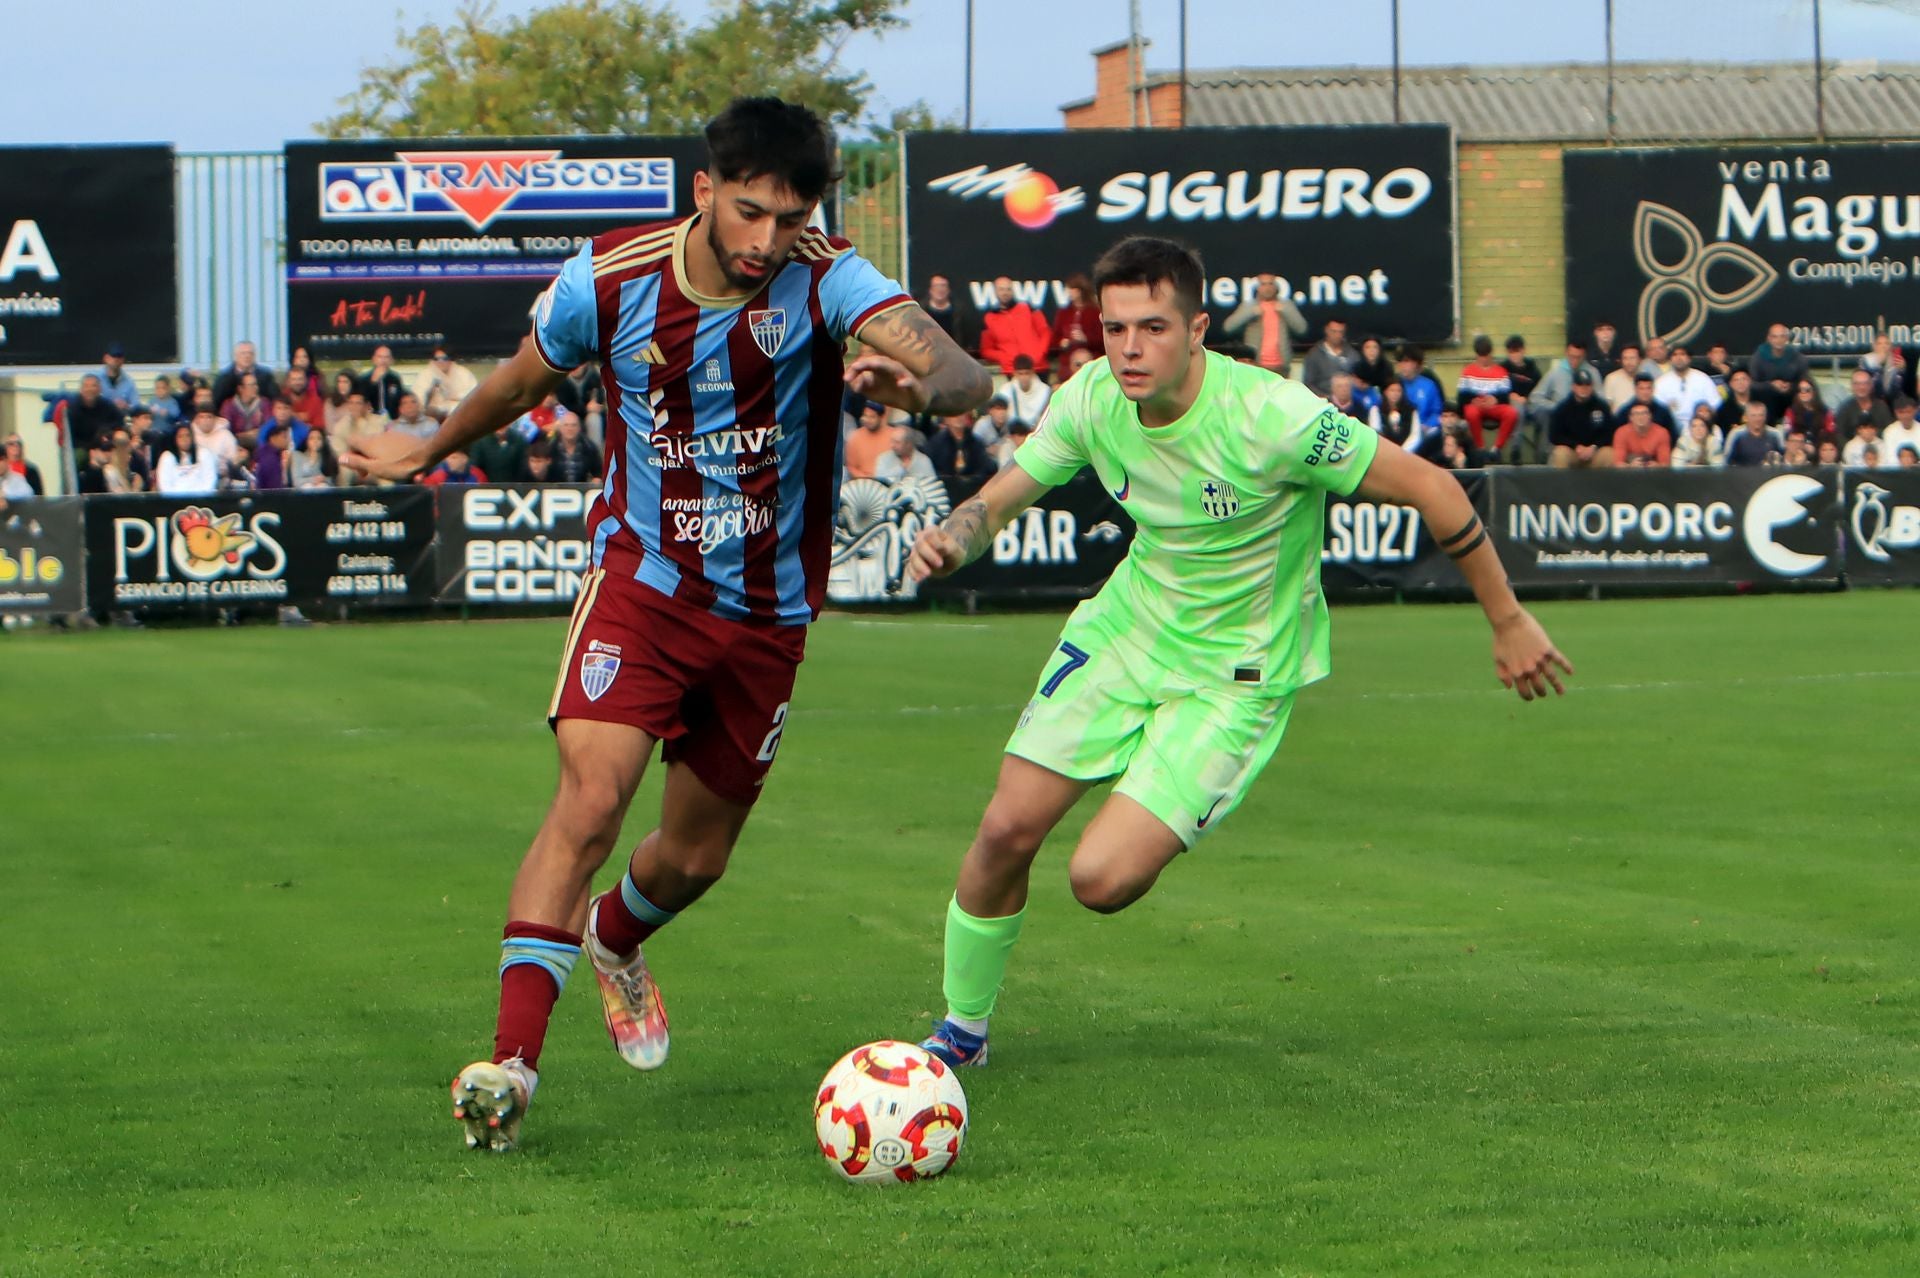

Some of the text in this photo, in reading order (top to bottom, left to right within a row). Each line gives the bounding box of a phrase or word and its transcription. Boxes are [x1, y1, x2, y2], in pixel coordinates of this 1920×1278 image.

[411, 161, 668, 189] TRANSCOSE
[1719, 157, 1831, 181] venta
[1096, 168, 1432, 221] SIGUERO
[300, 239, 350, 254] TODO
[351, 239, 394, 253] PARA
[396, 238, 415, 253] EL
[522, 236, 571, 251] TODO
[1788, 255, 1907, 286] Complejo
[696, 382, 735, 393] SEGOVIA
[1304, 409, 1336, 467] BARÇA
[710, 453, 782, 478] Fundación
[662, 494, 730, 512] amanece
[674, 503, 774, 556] segovia
[1508, 502, 1734, 542] INNOPORC
[114, 579, 288, 599] SERVICIO DE CATERING
[1039, 640, 1091, 699] 7
